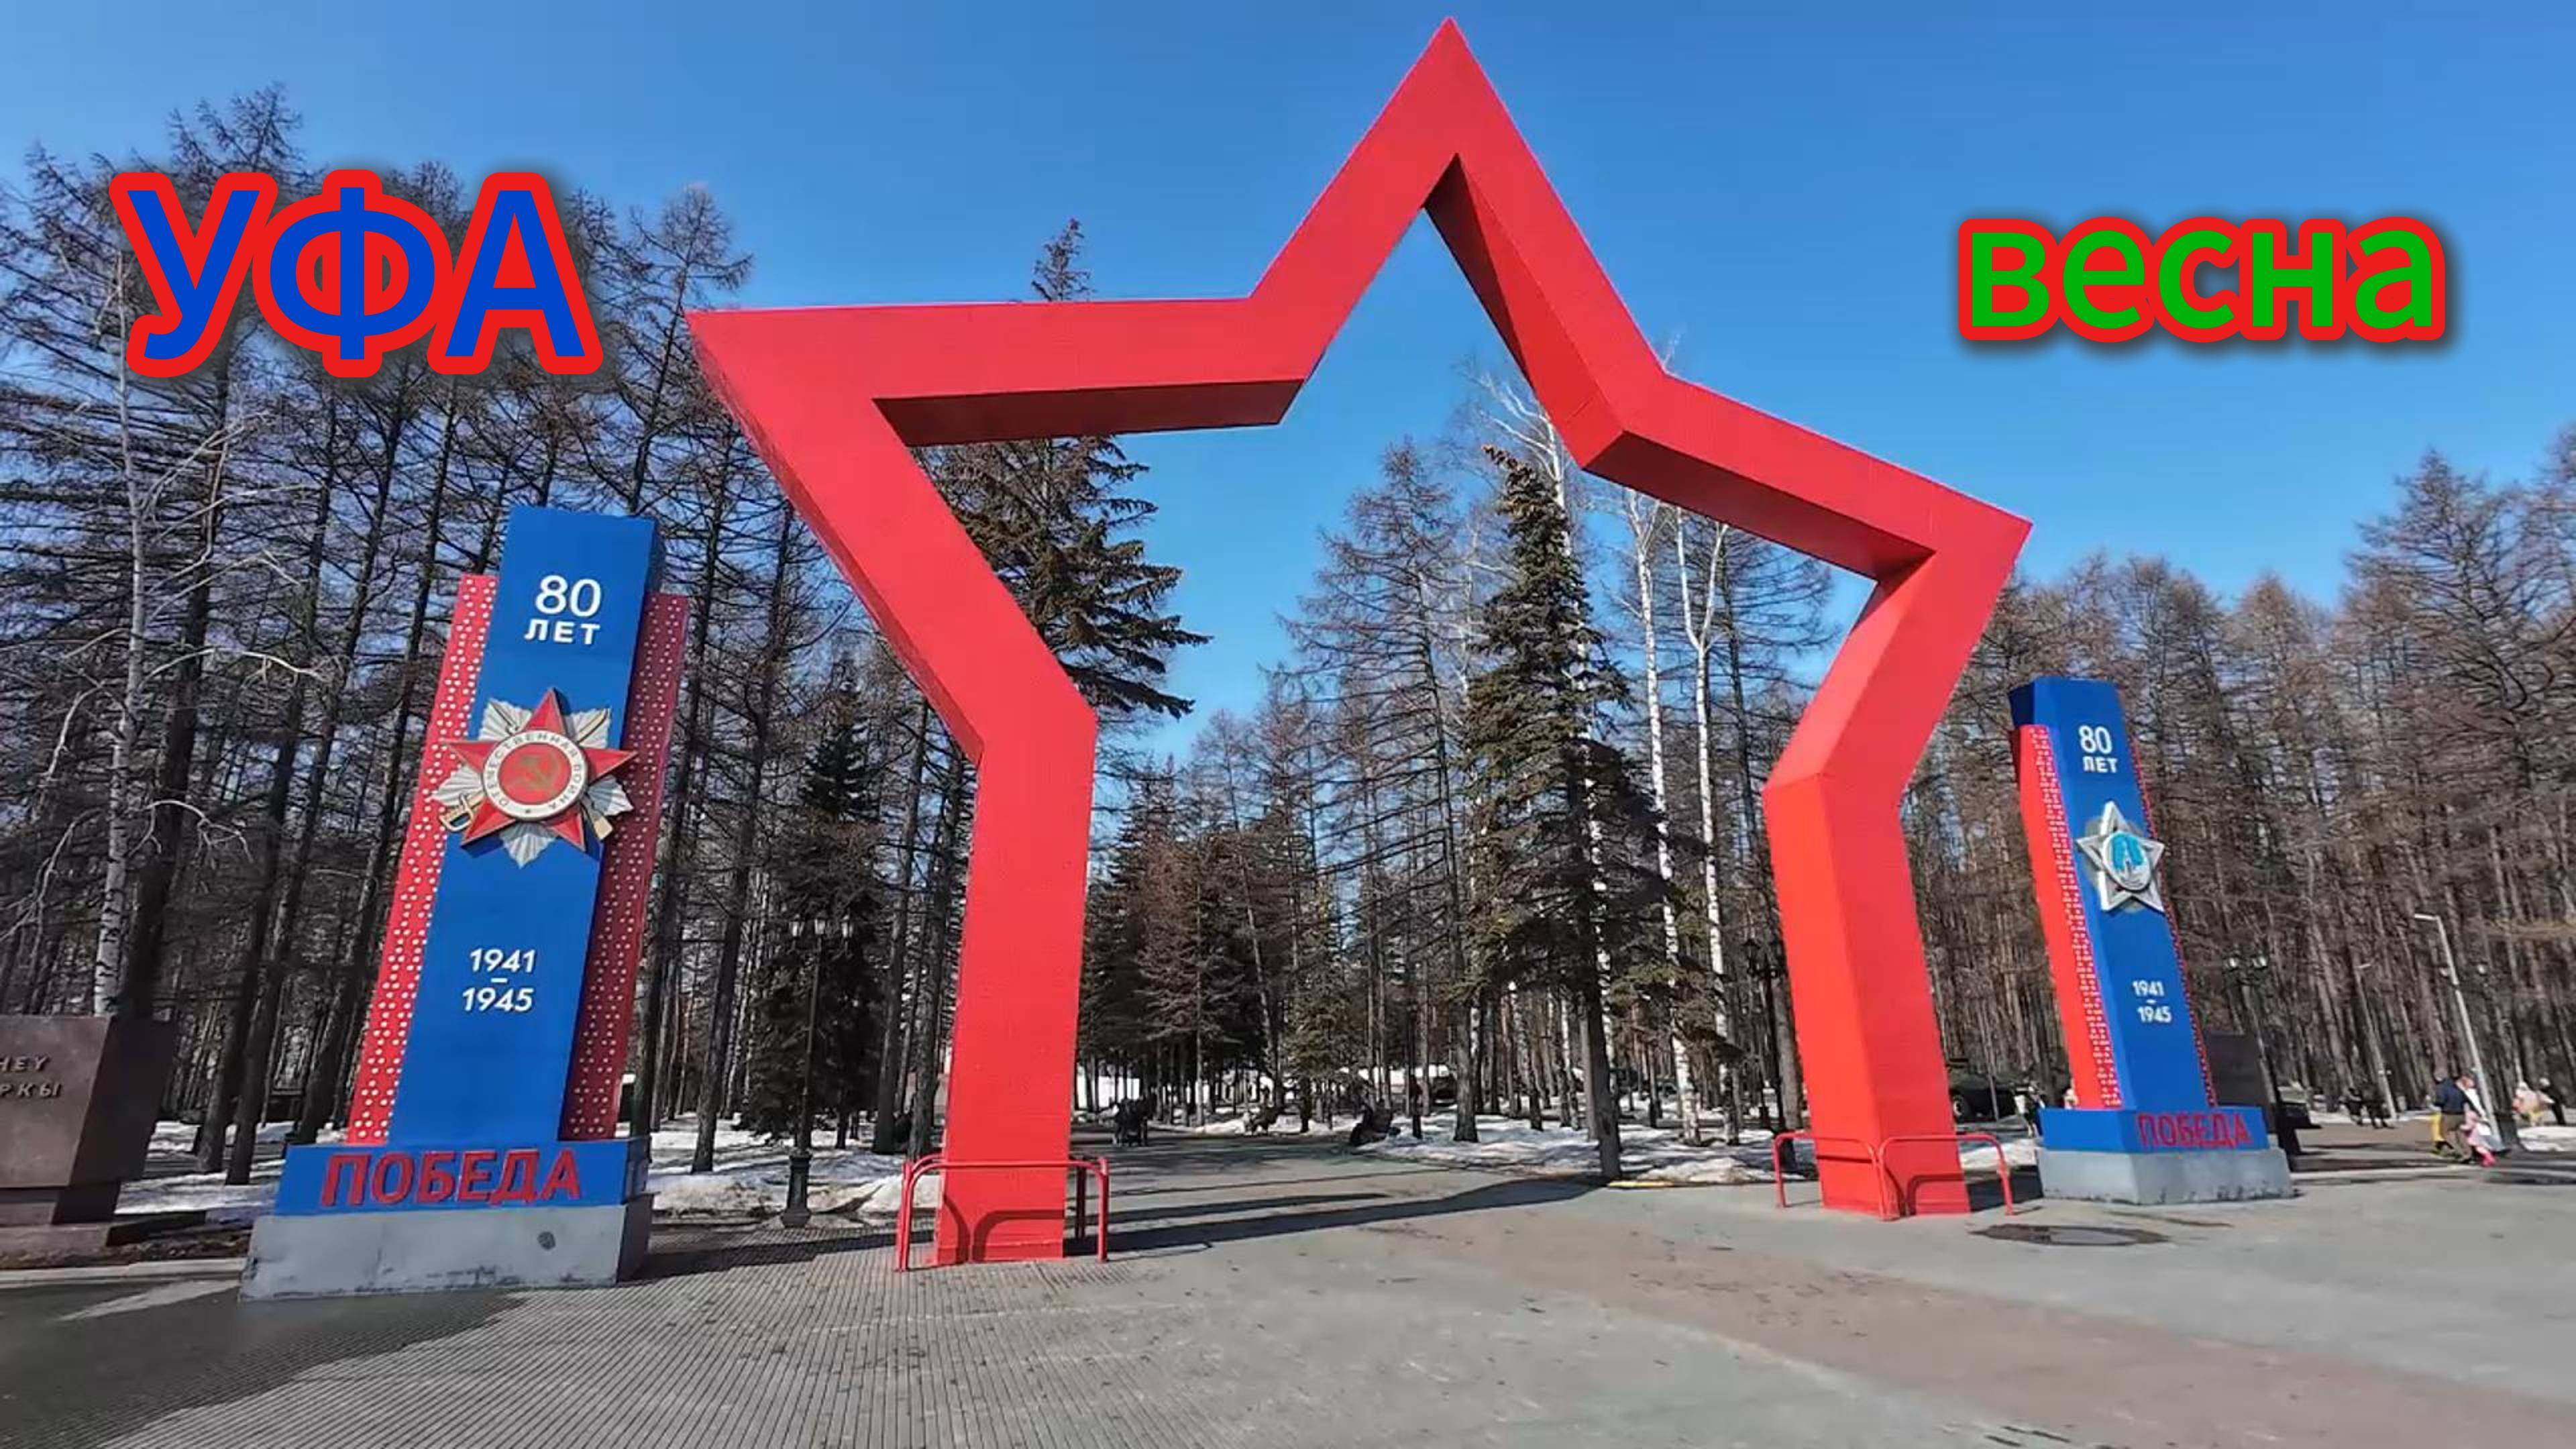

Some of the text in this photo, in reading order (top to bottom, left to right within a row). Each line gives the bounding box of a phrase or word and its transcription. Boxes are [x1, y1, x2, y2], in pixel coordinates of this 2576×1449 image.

[535, 575, 602, 618] 80
[524, 619, 601, 645] ЛЕТ
[2078, 724, 2112, 754] 80
[470, 948, 536, 973] 1941
[462, 987, 535, 1012] 1945
[2132, 980, 2165, 997] 1941
[2137, 1006, 2173, 1023] 1945
[2138, 1112, 2254, 1150] ПОБЕДА
[321, 1147, 582, 1207] ПОБЕДА
